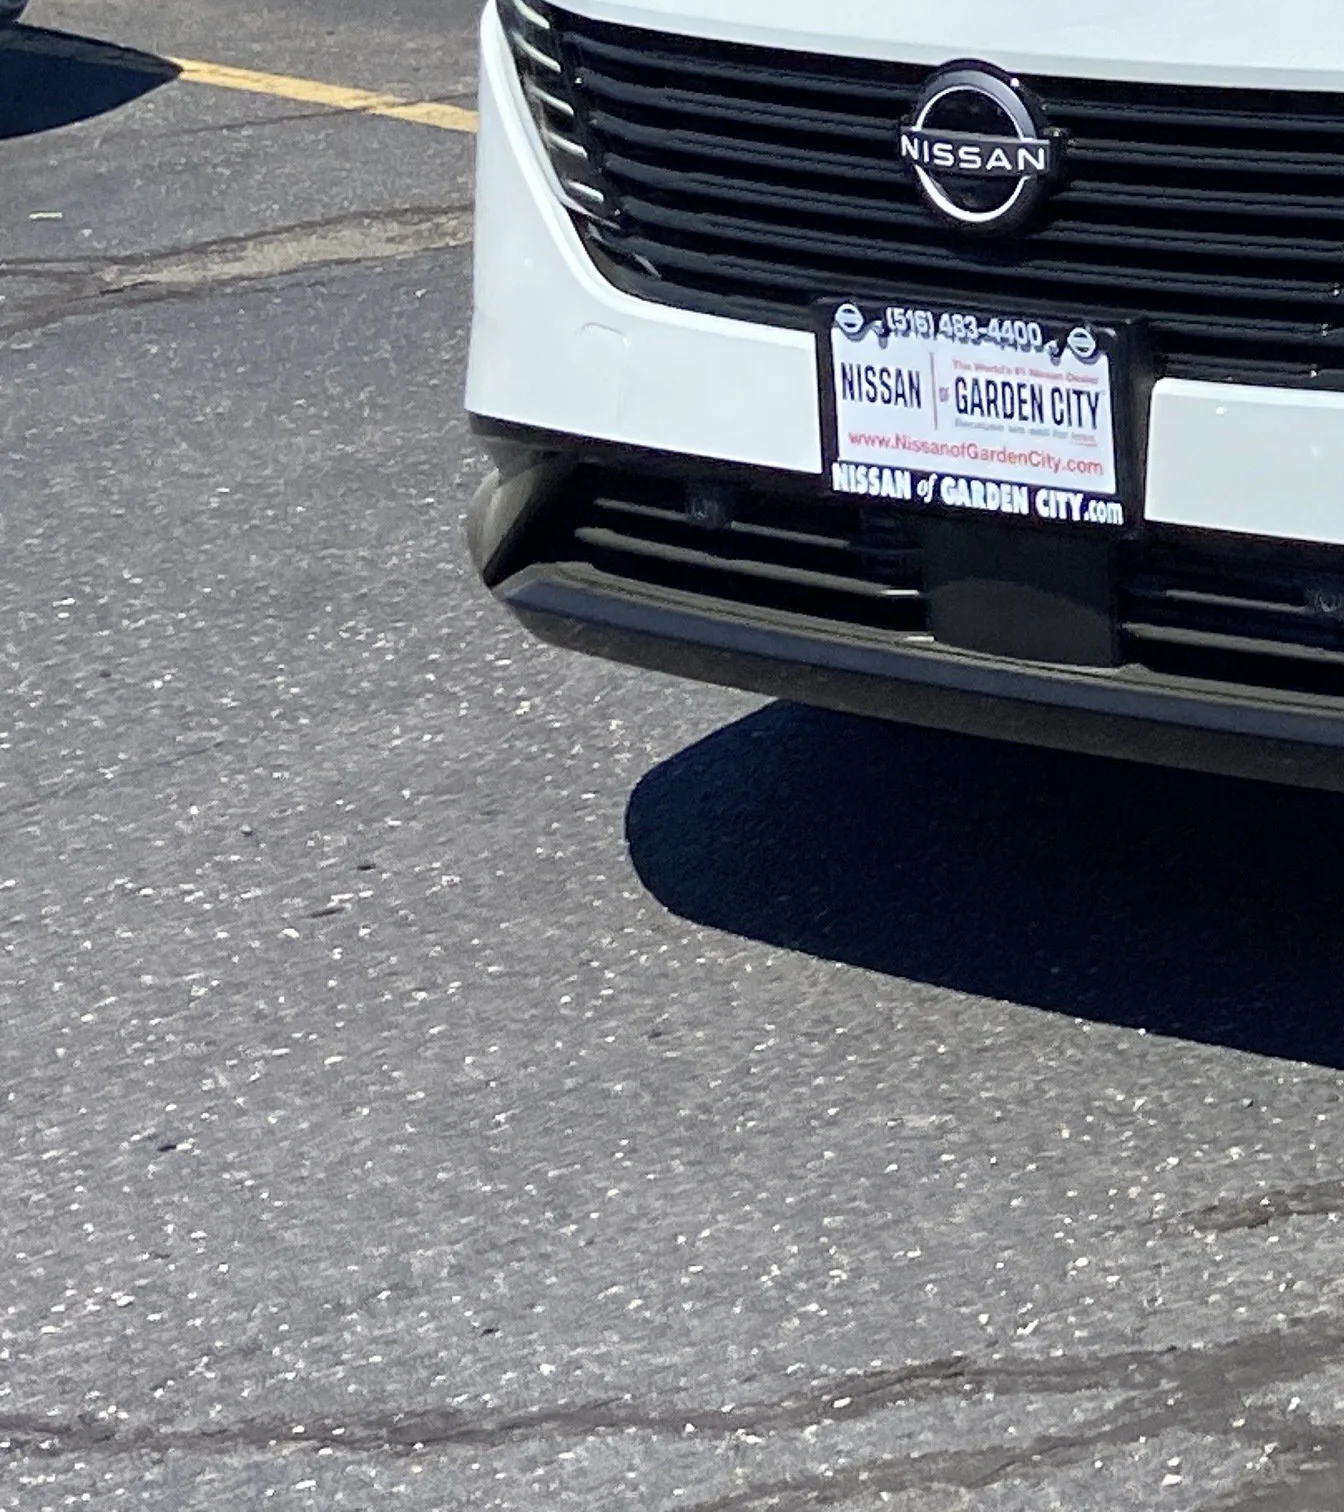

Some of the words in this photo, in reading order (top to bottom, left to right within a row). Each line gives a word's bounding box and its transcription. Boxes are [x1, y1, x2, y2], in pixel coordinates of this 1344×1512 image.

[901, 135, 1046, 171] NISSAN
[886, 307, 934, 338] (516)
[939, 313, 1042, 348] 483-4400
[840, 361, 921, 409] NISSAN
[955, 376, 1045, 425] GARDEN
[1051, 386, 1100, 430] CITY
[848, 432, 1104, 476] www.NissanofGardenCity.com
[831, 461, 912, 501] NISSAN
[916, 472, 938, 504] of
[940, 476, 1030, 516] GARDEN
[1035, 488, 1124, 526] CITY.com
